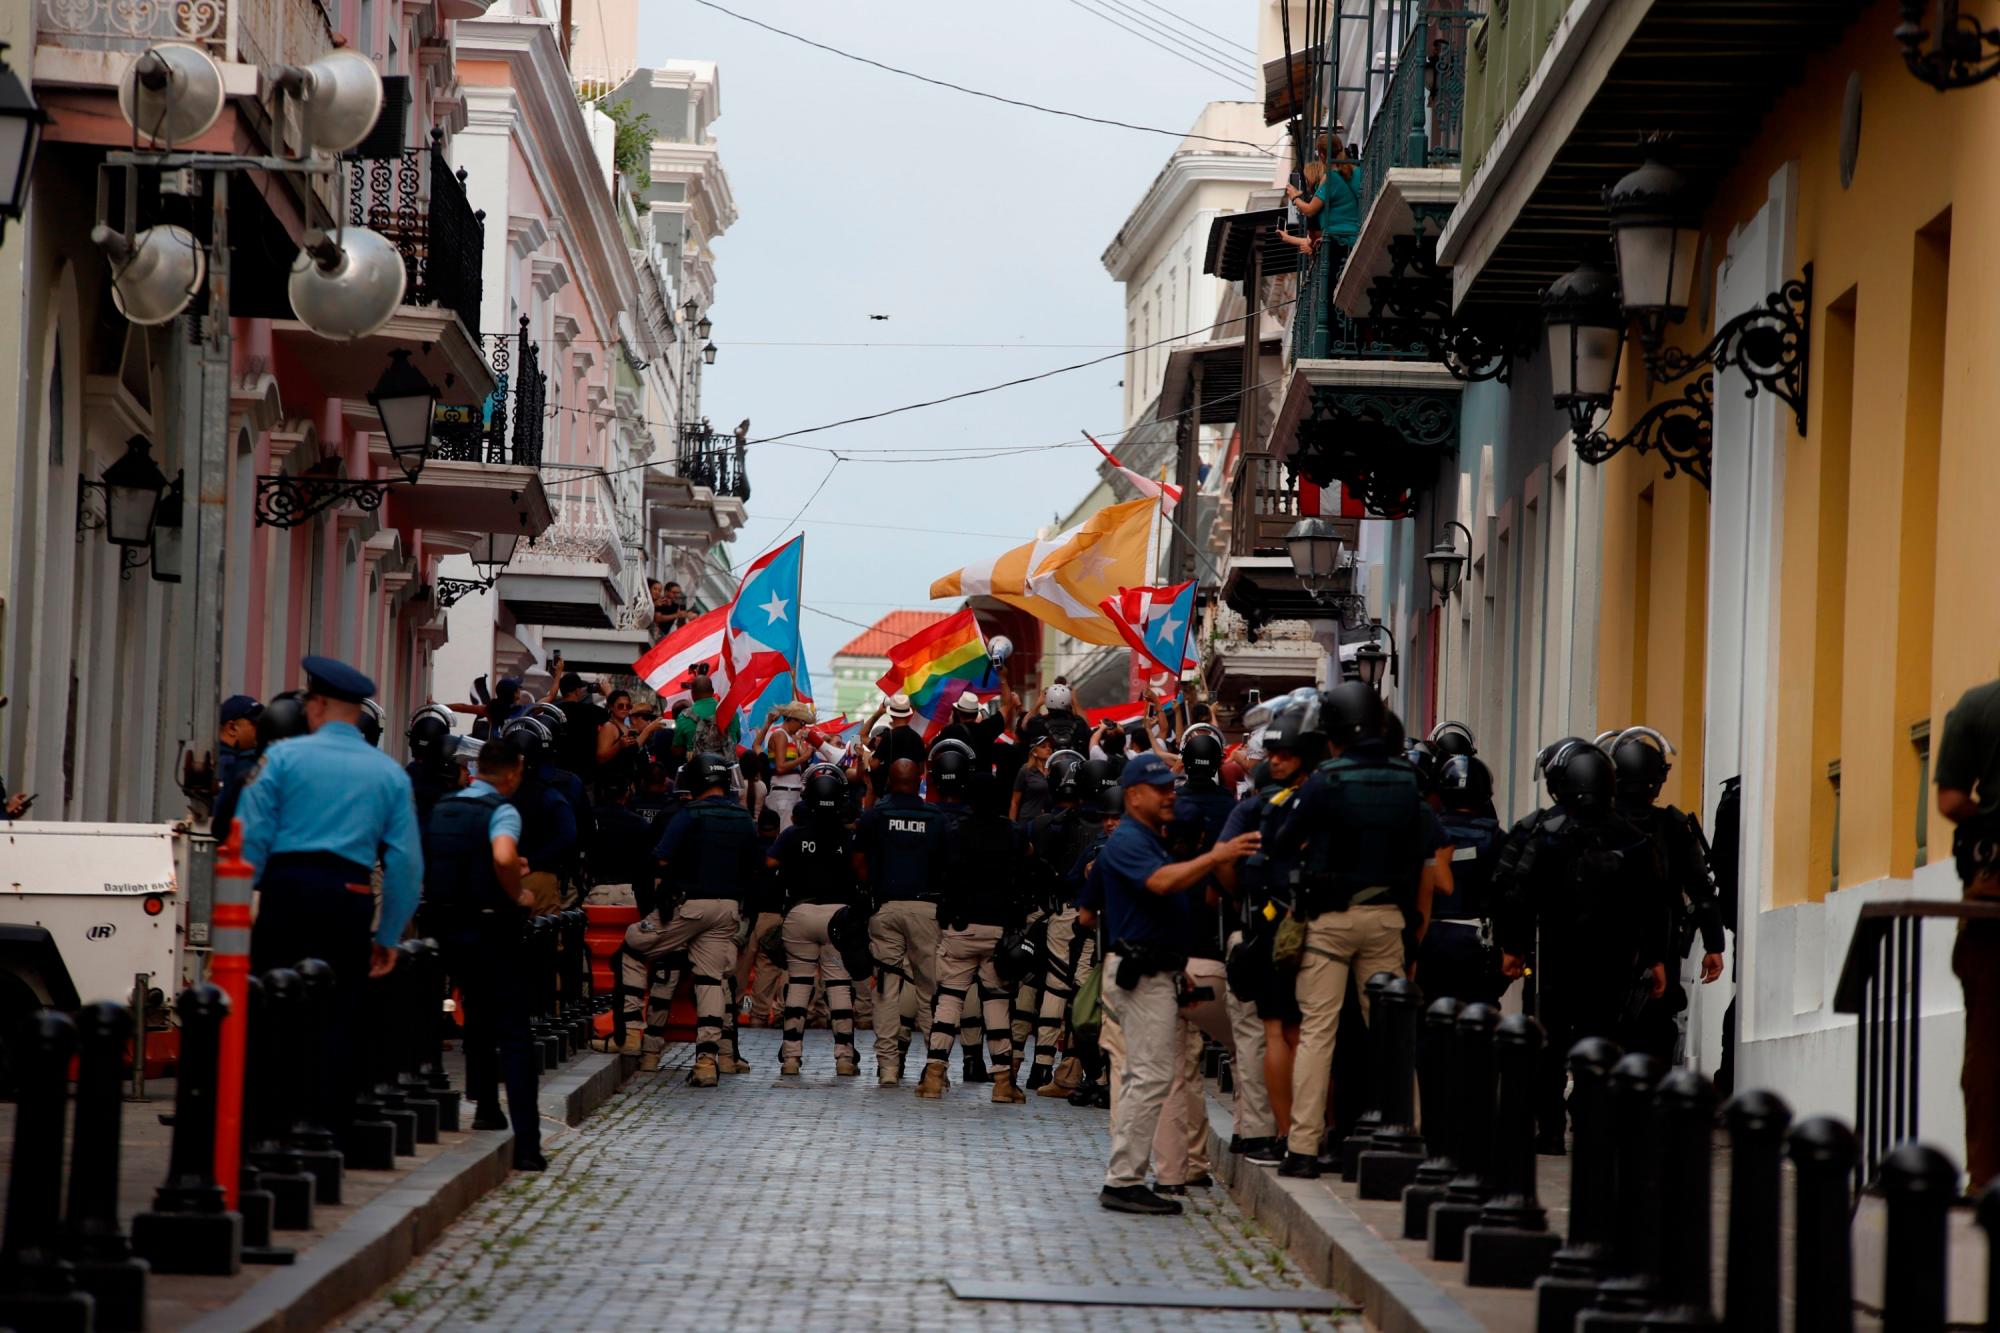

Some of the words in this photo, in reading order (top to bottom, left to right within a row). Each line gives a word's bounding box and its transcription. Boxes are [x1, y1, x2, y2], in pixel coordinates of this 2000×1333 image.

[889, 819, 926, 833] POLICIA
[103, 882, 149, 892] Daylight
[91, 926, 111, 938] IR
